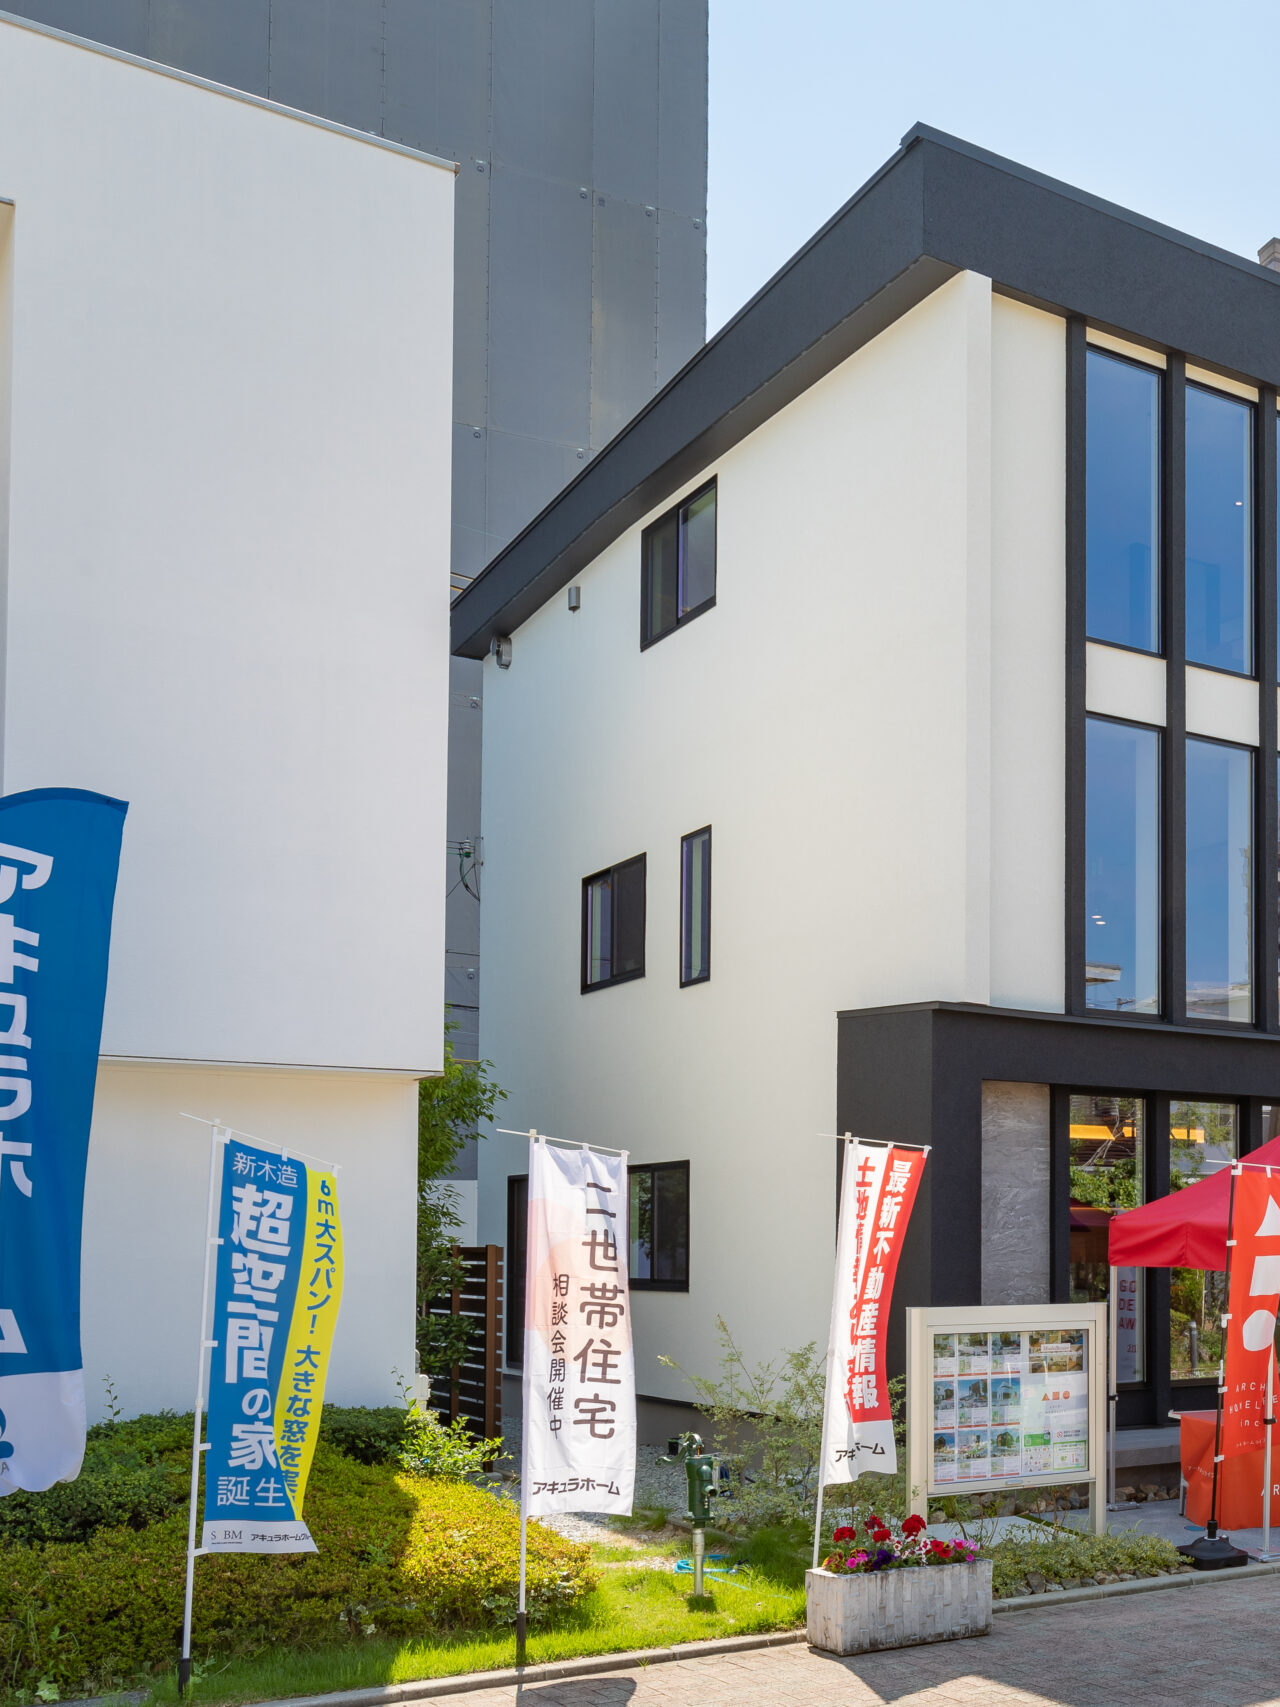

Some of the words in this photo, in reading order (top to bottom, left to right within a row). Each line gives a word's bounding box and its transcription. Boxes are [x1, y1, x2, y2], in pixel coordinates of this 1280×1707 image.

[232, 1151, 298, 1188] 新木造
[225, 1183, 293, 1470] 超空間の家
[573, 1182, 625, 1441] 二世帯住宅
[852, 1159, 913, 1410] 最新不動産情報
[547, 1272, 570, 1440] 相談会開催中
[1235, 1382, 1267, 1393] ARCH
[217, 1475, 286, 1507] 誕生
[532, 1477, 621, 1496] アキュラホーム
